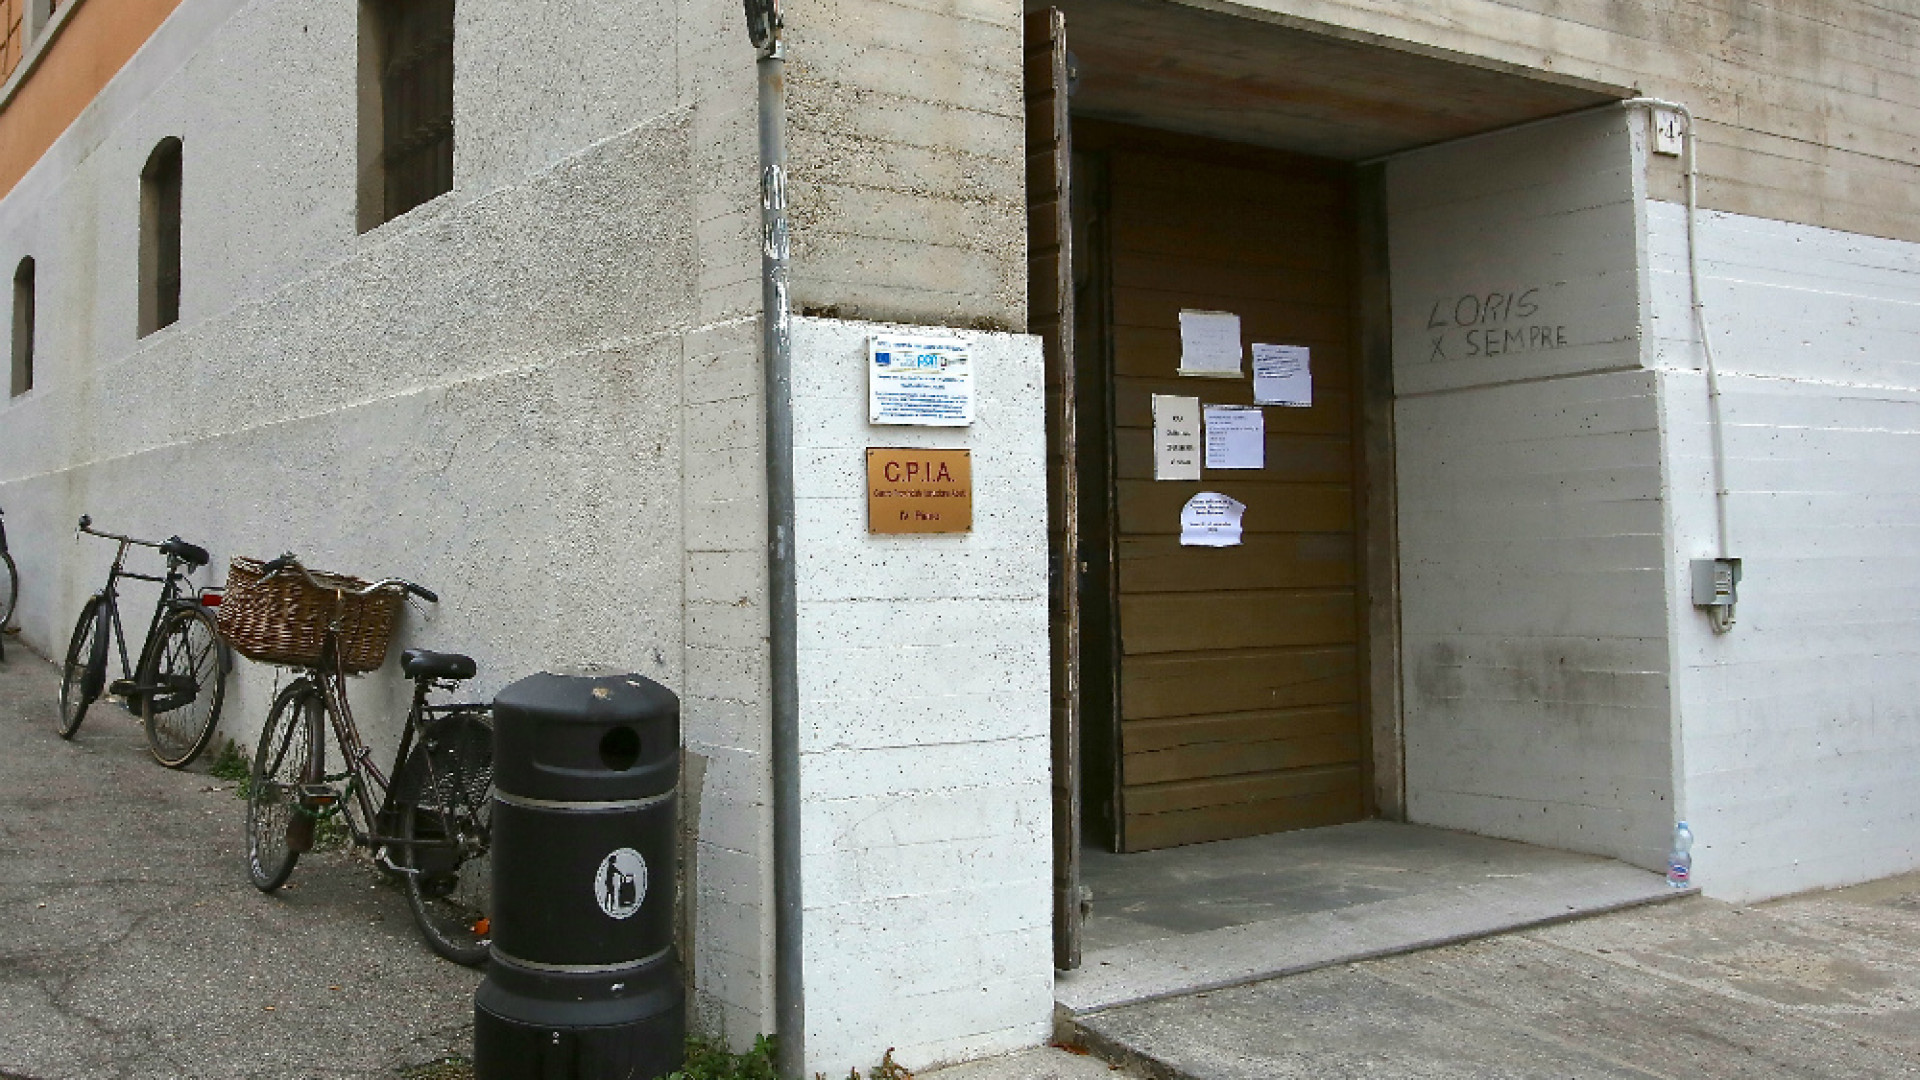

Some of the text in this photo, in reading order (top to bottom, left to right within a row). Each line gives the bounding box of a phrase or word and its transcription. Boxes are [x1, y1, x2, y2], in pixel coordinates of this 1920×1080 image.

[1427, 287, 1539, 330] LORIS
[1466, 325, 1568, 357] SEMPRE
[884, 461, 955, 482] C.P.I.A.
